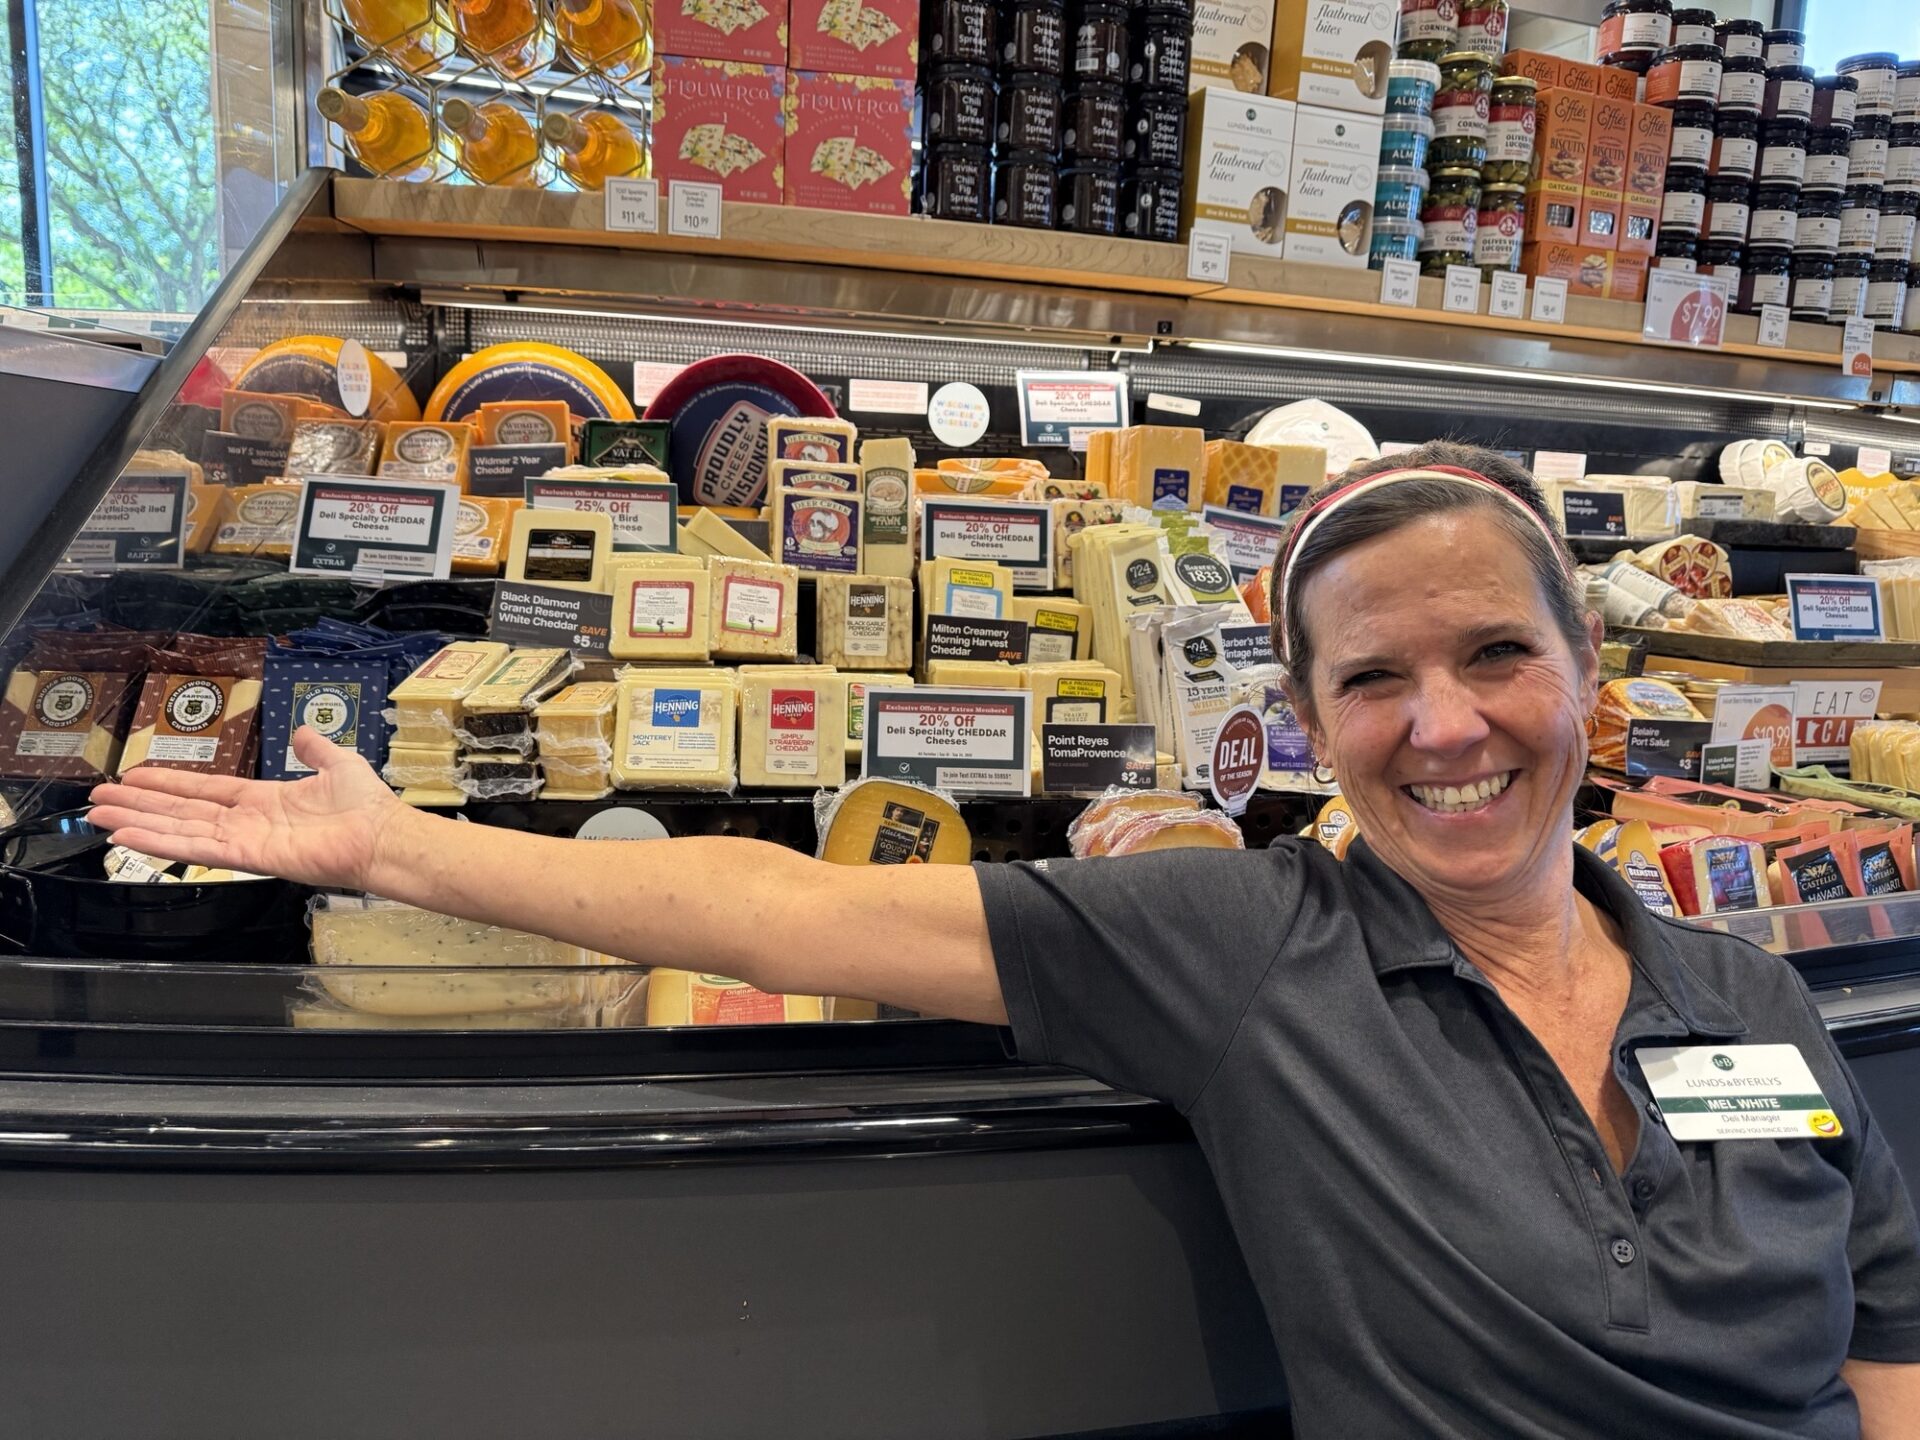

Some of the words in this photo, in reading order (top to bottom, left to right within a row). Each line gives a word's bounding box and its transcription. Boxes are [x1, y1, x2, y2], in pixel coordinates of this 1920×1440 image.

[1315, 4, 1369, 25] flatbread
[1316, 20, 1341, 35] bites
[959, 33, 986, 47] Spread
[1033, 44, 1059, 57] Spread
[1523, 58, 1554, 83] Effie's
[1564, 67, 1592, 91] Effie's
[1605, 74, 1632, 99] Effie's
[962, 95, 981, 106] Chili
[966, 105, 978, 116] Fig
[1025, 106, 1053, 118] Orange
[1555, 96, 1587, 123] Effie's
[957, 114, 984, 126] Spread
[1034, 116, 1046, 126] Fig
[1101, 117, 1113, 128] Fig
[1597, 105, 1627, 130] Effie's
[1026, 123, 1052, 134] Spread
[1157, 123, 1175, 134] Sour
[1638, 112, 1668, 137] Effie's
[1093, 125, 1118, 138] Spread
[1152, 132, 1178, 145] Cherry
[1152, 141, 1177, 152] Spread
[1550, 137, 1585, 154] BISCUITS
[1592, 144, 1625, 161] BISCUITS
[1209, 151, 1264, 171] flatbread
[1633, 152, 1664, 168] BISCUITS
[955, 175, 975, 186] Chili
[1210, 167, 1235, 182] bites
[1298, 167, 1352, 185] flatbread
[959, 185, 971, 195] Fig
[1023, 183, 1051, 195] Orange
[1299, 182, 1324, 197] bites
[1547, 182, 1577, 193] OATCAKE
[951, 192, 978, 205] Spread
[1032, 192, 1044, 203] Fig
[1101, 195, 1112, 205] Fig
[1589, 190, 1618, 200] OATCAKE
[1023, 201, 1050, 213] Spread
[1681, 302, 1721, 330] $7.99
[1077, 391, 1091, 400] Off
[612, 448, 631, 458] VAT
[702, 411, 751, 499] PROUDLY
[475, 457, 511, 465] Widmer
[512, 456, 518, 464] 2
[520, 456, 540, 464] Year
[720, 431, 754, 490] CHEESE
[475, 466, 514, 475] Cheddar
[793, 474, 817, 483] DEER
[819, 474, 848, 487] CREEK
[574, 490, 591, 498] Offer
[607, 491, 629, 499] Extras
[349, 502, 376, 516] 20%
[379, 504, 400, 516] Off
[574, 500, 605, 513] 25%
[609, 500, 632, 513] Off
[793, 500, 818, 510] DEER
[819, 500, 850, 515] CREEK
[319, 511, 337, 520] Deli
[338, 512, 379, 523] Specialty
[381, 515, 426, 526] CHEDDAR
[619, 514, 639, 523] Bird
[352, 521, 390, 532] Cheeses
[965, 522, 989, 534] 20%
[993, 523, 1009, 534] Off
[940, 531, 955, 539] Deli
[957, 532, 994, 543] Specialty
[995, 535, 1034, 543] CHEDDAR
[1233, 532, 1251, 543] 20%
[1253, 535, 1266, 546] Off
[970, 540, 1004, 549] Cheeses
[1234, 549, 1260, 559] Cheeses
[312, 557, 346, 567] EXTRAS
[1130, 562, 1152, 578] 724
[1187, 570, 1222, 584] 1833
[501, 591, 530, 603] Black
[532, 595, 580, 610] Diamond
[850, 594, 884, 607] HENNING
[1820, 596, 1837, 605] 20%
[1838, 596, 1851, 606] Off
[499, 602, 532, 615] Grand
[535, 607, 578, 621] Reserve
[499, 612, 531, 625] White
[532, 617, 578, 631] Cheddar
[580, 625, 608, 637] SAVE
[932, 624, 962, 635] Milton
[963, 626, 1010, 641] Creamery
[931, 635, 971, 648] Morning
[972, 638, 1009, 649] Harvest
[930, 645, 973, 656] Cheddar
[998, 651, 1023, 660] SAVE
[305, 688, 321, 700] OLD
[323, 687, 349, 701] WORLD
[1186, 687, 1200, 698] 15
[1201, 685, 1225, 695] YEAR
[166, 680, 213, 713] CHERRYWOOD
[211, 683, 224, 716] SMOKED
[1812, 691, 1853, 715] EAT
[655, 701, 698, 714] HENNING
[773, 702, 813, 717] HENNING
[885, 703, 917, 711] Exclusive
[975, 707, 1008, 715] Members!
[171, 720, 209, 732] CHEDDAR
[919, 714, 949, 727] 20%
[954, 715, 976, 728] Off
[632, 734, 672, 742] MONTEREY
[887, 726, 906, 735] Deli
[908, 727, 955, 738] Specialty
[957, 728, 1007, 738] CHEDDAR
[1632, 727, 1660, 737] Belaire
[769, 739, 816, 747] STRAWBERRY
[925, 736, 968, 746] Cheeses
[1048, 735, 1076, 746] Point
[1078, 736, 1109, 748] Reyes
[1631, 737, 1648, 747] Port
[1649, 737, 1671, 748] Salut
[775, 745, 809, 753] CHEDDAR
[1048, 748, 1126, 758] TomaProvence
[1219, 737, 1258, 771] DEAL
[1125, 762, 1151, 770] SAVE
[1679, 759, 1692, 770] $3
[1228, 773, 1237, 781] THE
[1238, 771, 1253, 780] SEASON
[880, 841, 907, 855] GOUDA
[1711, 860, 1745, 871] CASTELLO
[1801, 875, 1837, 890] CASTELLO
[1872, 880, 1901, 896] HAVARTI
[1808, 885, 1845, 903] HAVARTI
[1686, 1077, 1782, 1088] LUNDS&BYERLYS
[1708, 1099, 1736, 1110] MEL
[1739, 1098, 1781, 1109] WHITE
[1721, 1115, 1740, 1123] Deli
[1741, 1114, 1781, 1123] Manager
